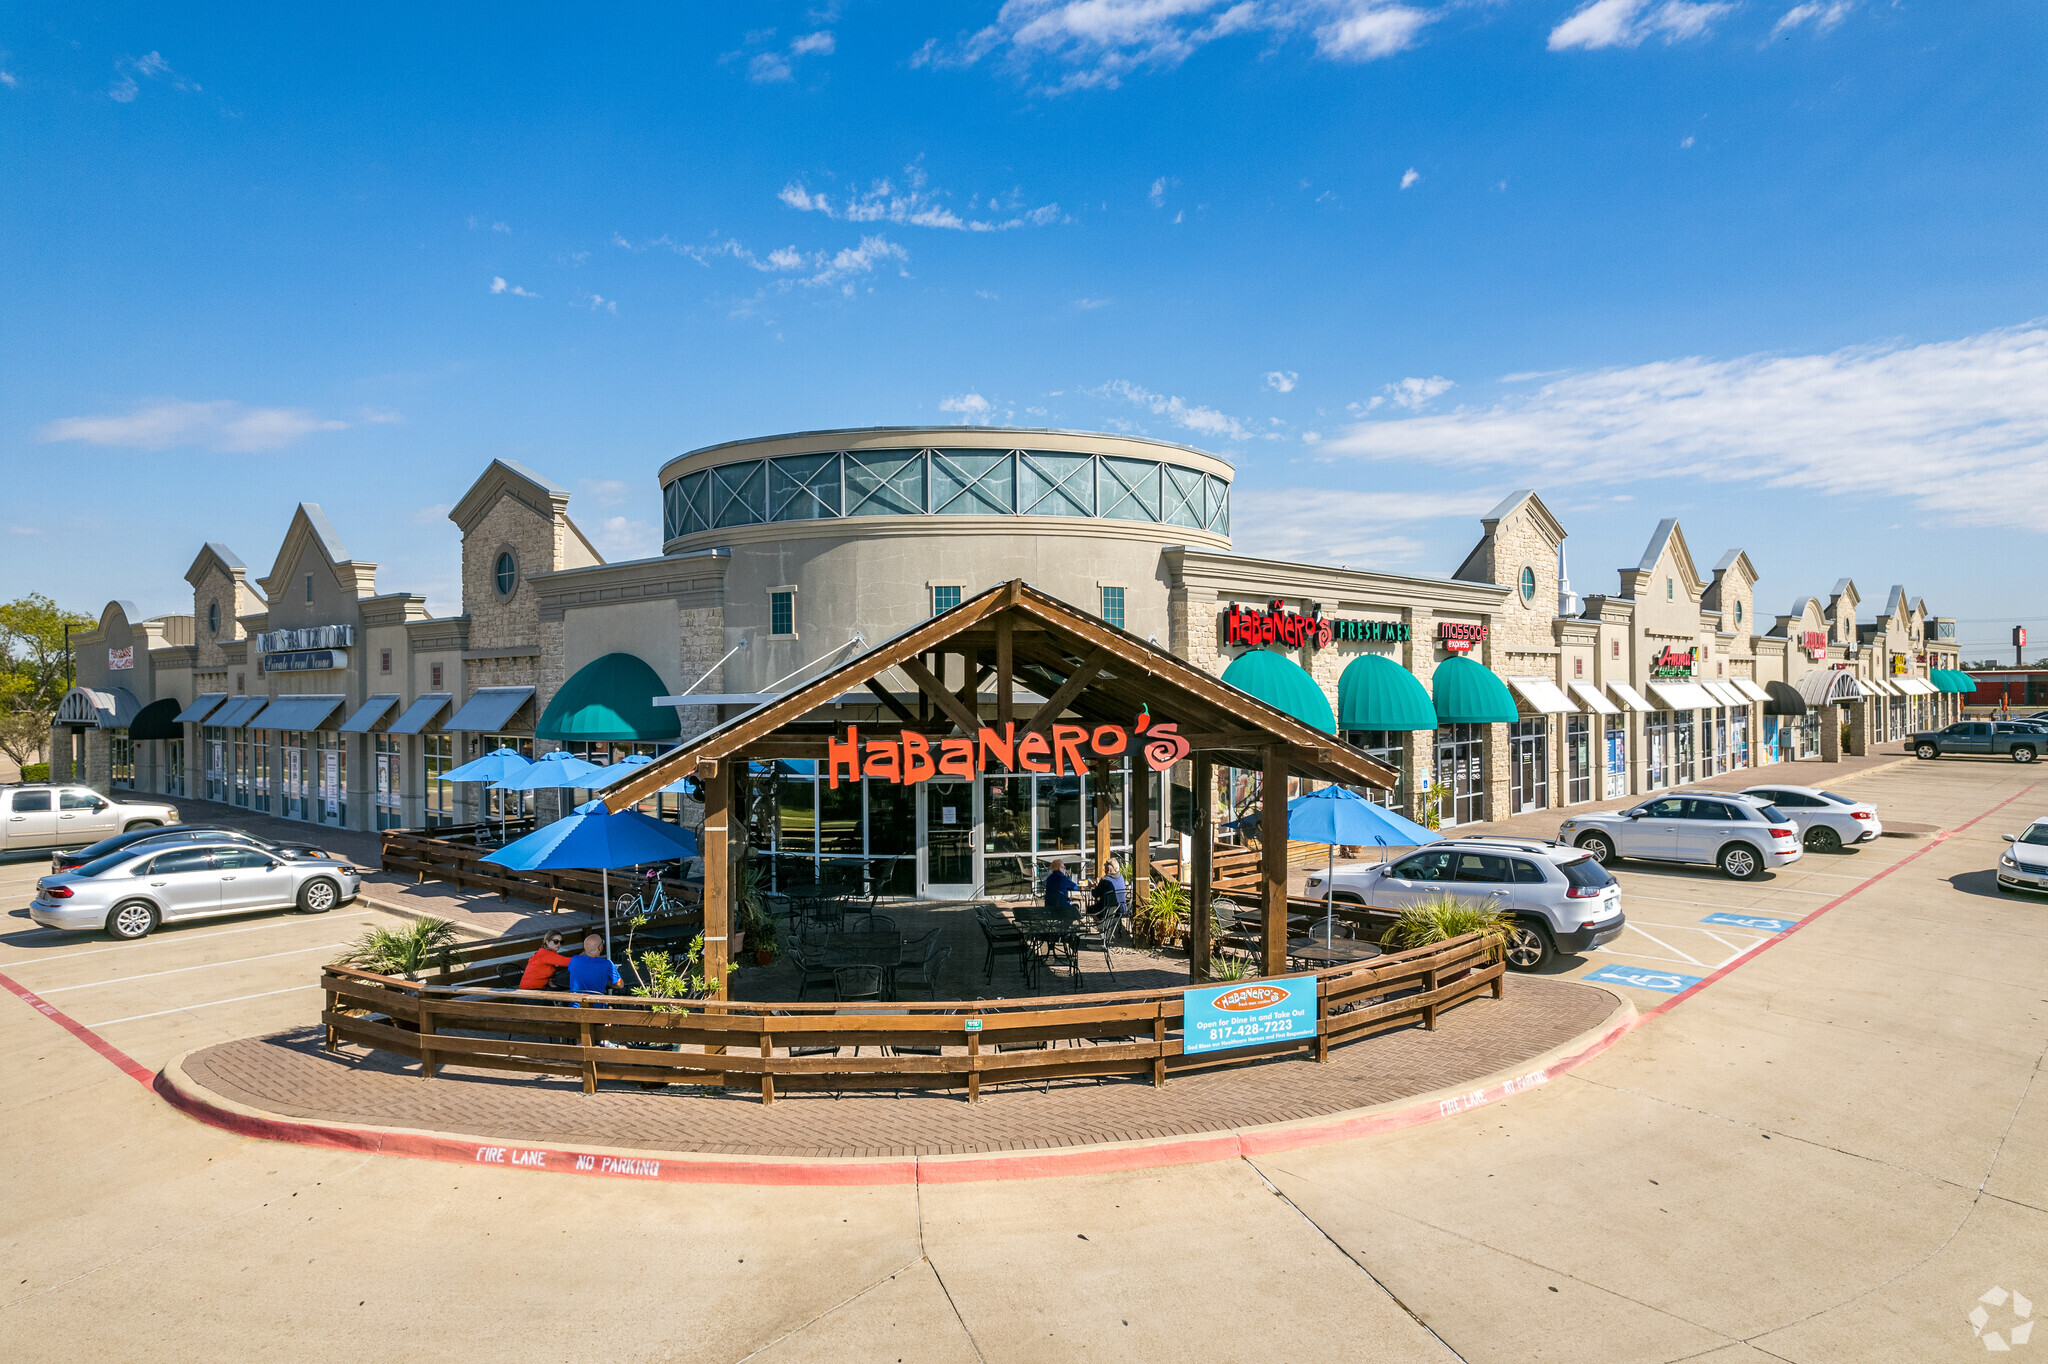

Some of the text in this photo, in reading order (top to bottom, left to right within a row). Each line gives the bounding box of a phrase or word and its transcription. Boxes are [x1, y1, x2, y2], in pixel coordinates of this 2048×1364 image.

[1340, 621, 1411, 641] FRESH MEX
[1442, 622, 1488, 645] massage
[1448, 640, 1470, 650] express
[266, 656, 288, 670] Private
[290, 654, 310, 669] Event
[1196, 1021, 1217, 1030] Open
[1218, 1018, 1230, 1026] for
[1231, 1016, 1248, 1024] Dine
[1258, 1013, 1273, 1021] and
[1274, 1010, 1291, 1018] Take
[1292, 1009, 1305, 1017] Out
[1210, 1019, 1292, 1040] 817-428-7223
[1198, 1042, 1212, 1050] Bless
[1221, 1037, 1247, 1046] Healthcare
[1439, 1070, 1548, 1117] FIRE LANE NO PARKING
[476, 1146, 660, 1177] FIRE LANE NO PARKING
